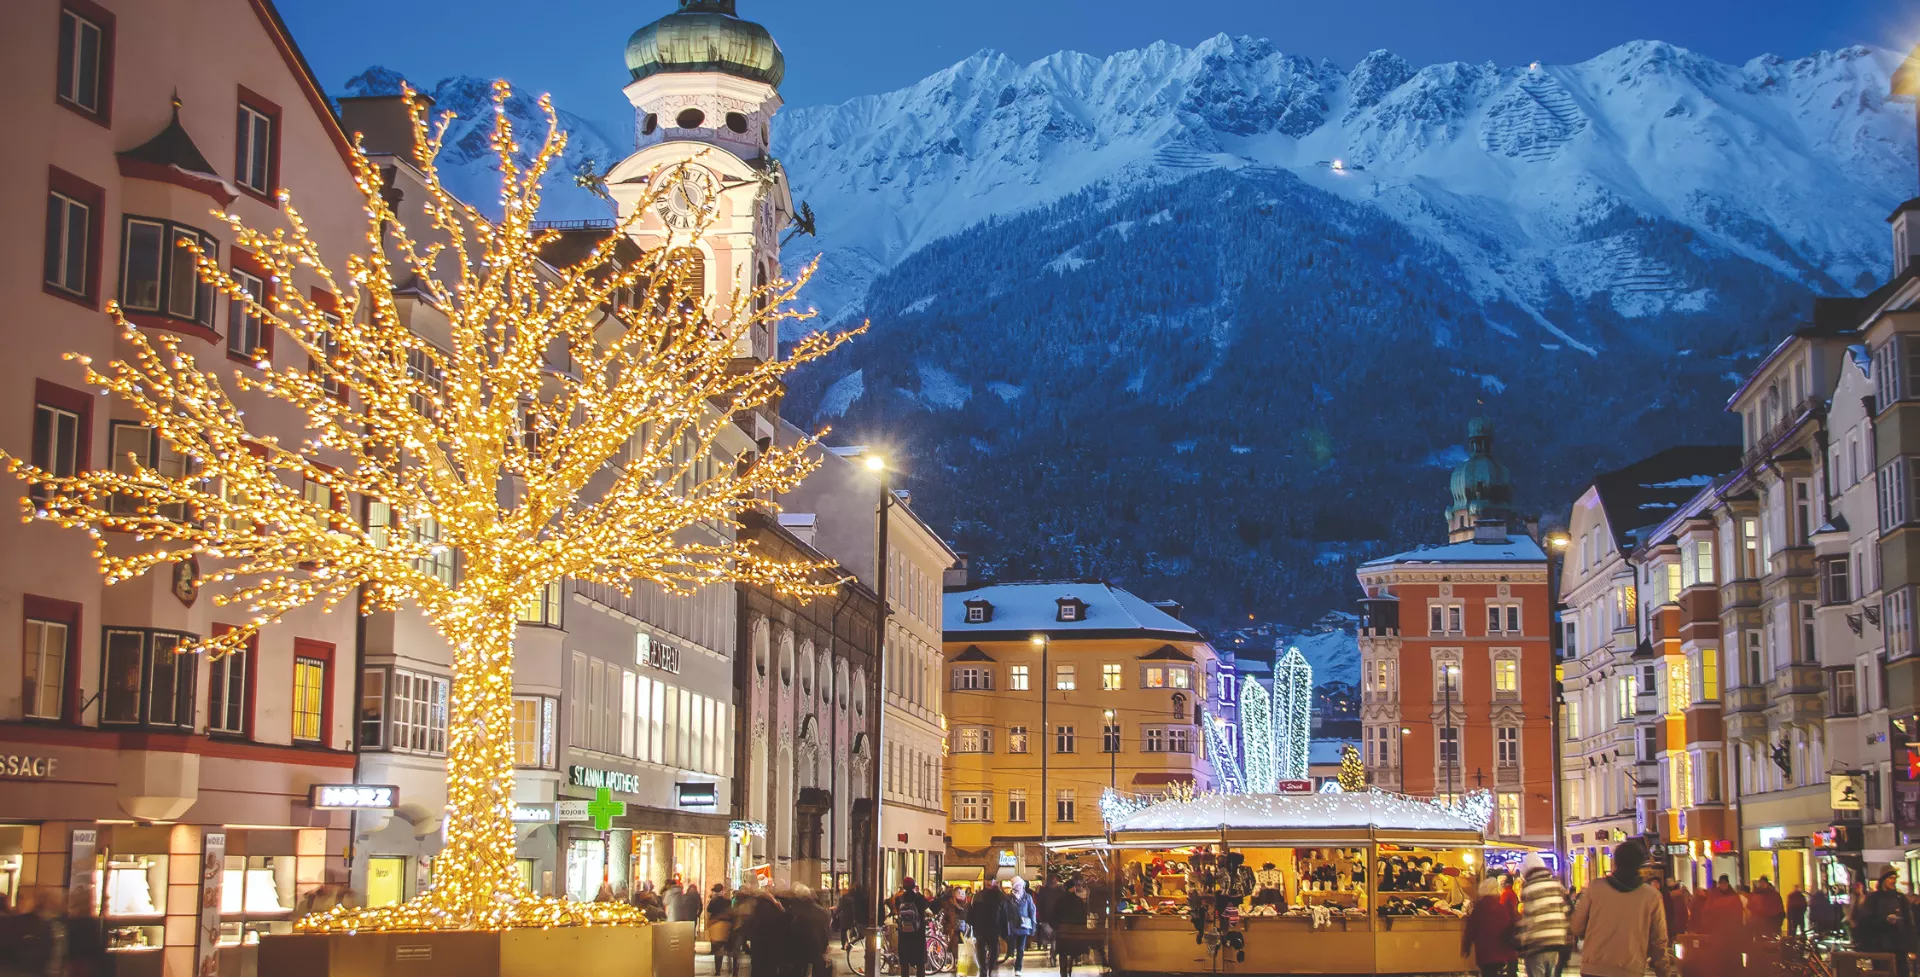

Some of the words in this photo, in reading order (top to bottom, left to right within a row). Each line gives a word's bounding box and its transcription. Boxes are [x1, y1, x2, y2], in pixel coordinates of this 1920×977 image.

[649, 639, 681, 675] GENERALI
[584, 767, 604, 788] ANNA
[606, 770, 640, 794] APOTHEKE
[321, 786, 392, 807] NORZ
[74, 832, 95, 843] NORZ
[207, 836, 225, 845] NORZ
